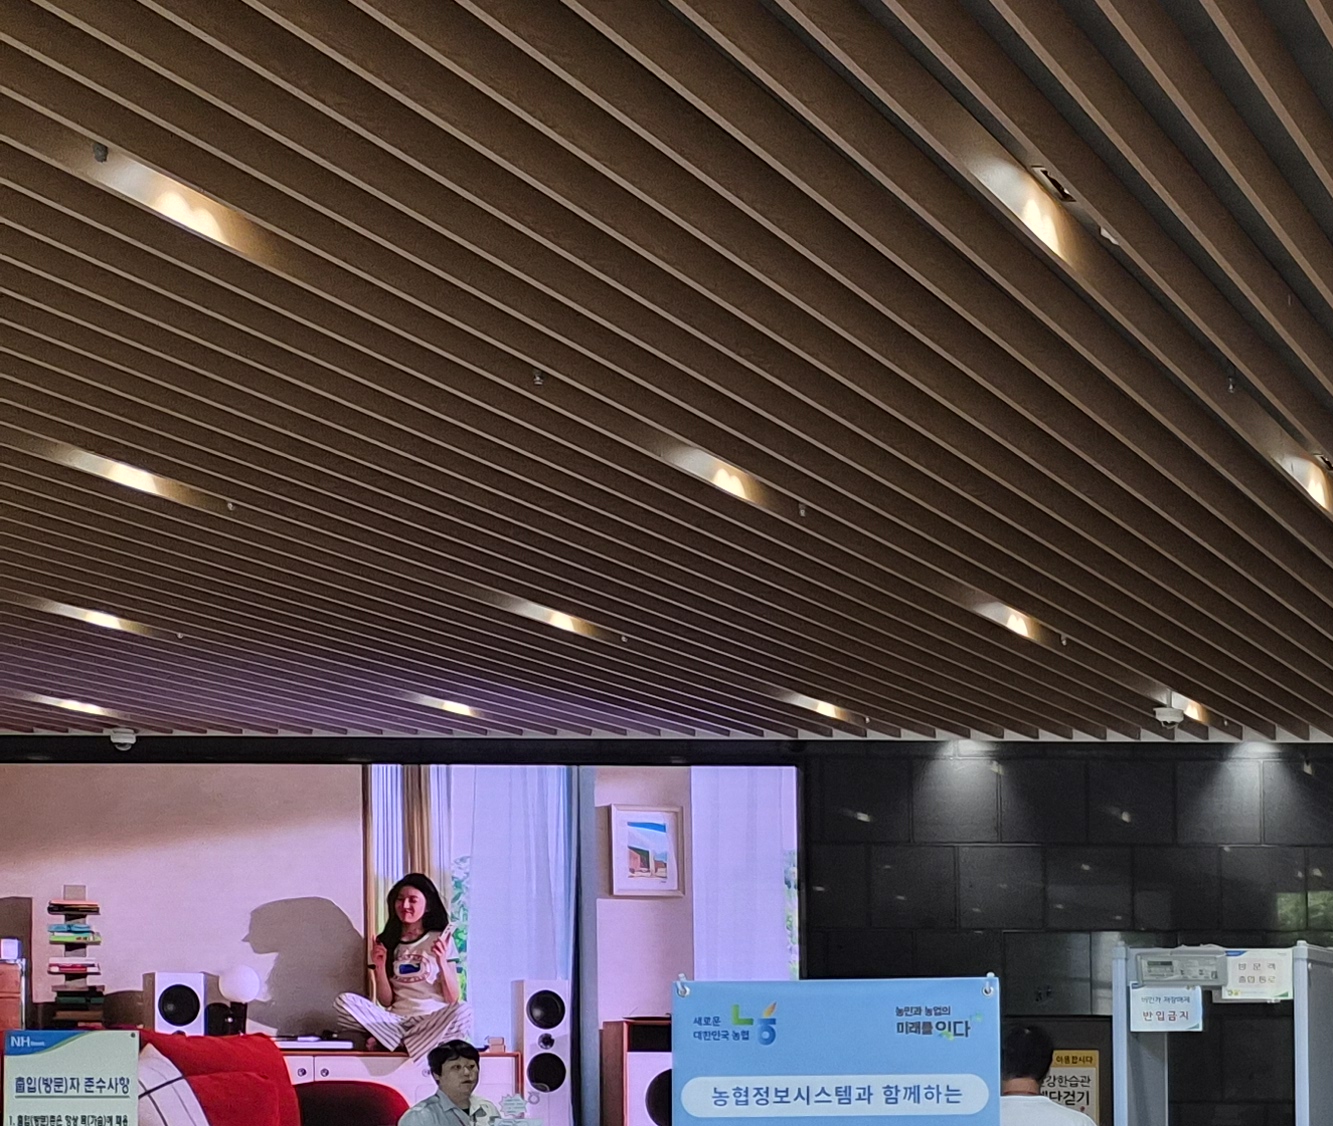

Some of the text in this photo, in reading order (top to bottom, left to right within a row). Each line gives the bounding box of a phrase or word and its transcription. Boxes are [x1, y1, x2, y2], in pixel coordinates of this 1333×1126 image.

[896, 1006, 922, 1017] 농민과
[1142, 1011, 1190, 1022] 반입금지
[693, 1016, 721, 1027] 새로운
[897, 1021, 933, 1035] 미래를
[693, 1030, 750, 1041] 대한민국 농협
[10, 1036, 31, 1047] NH
[15, 1076, 130, 1094] 출입(방문)자 준수사항
[711, 1083, 963, 1107] 농협정보시스템과 함께하는
